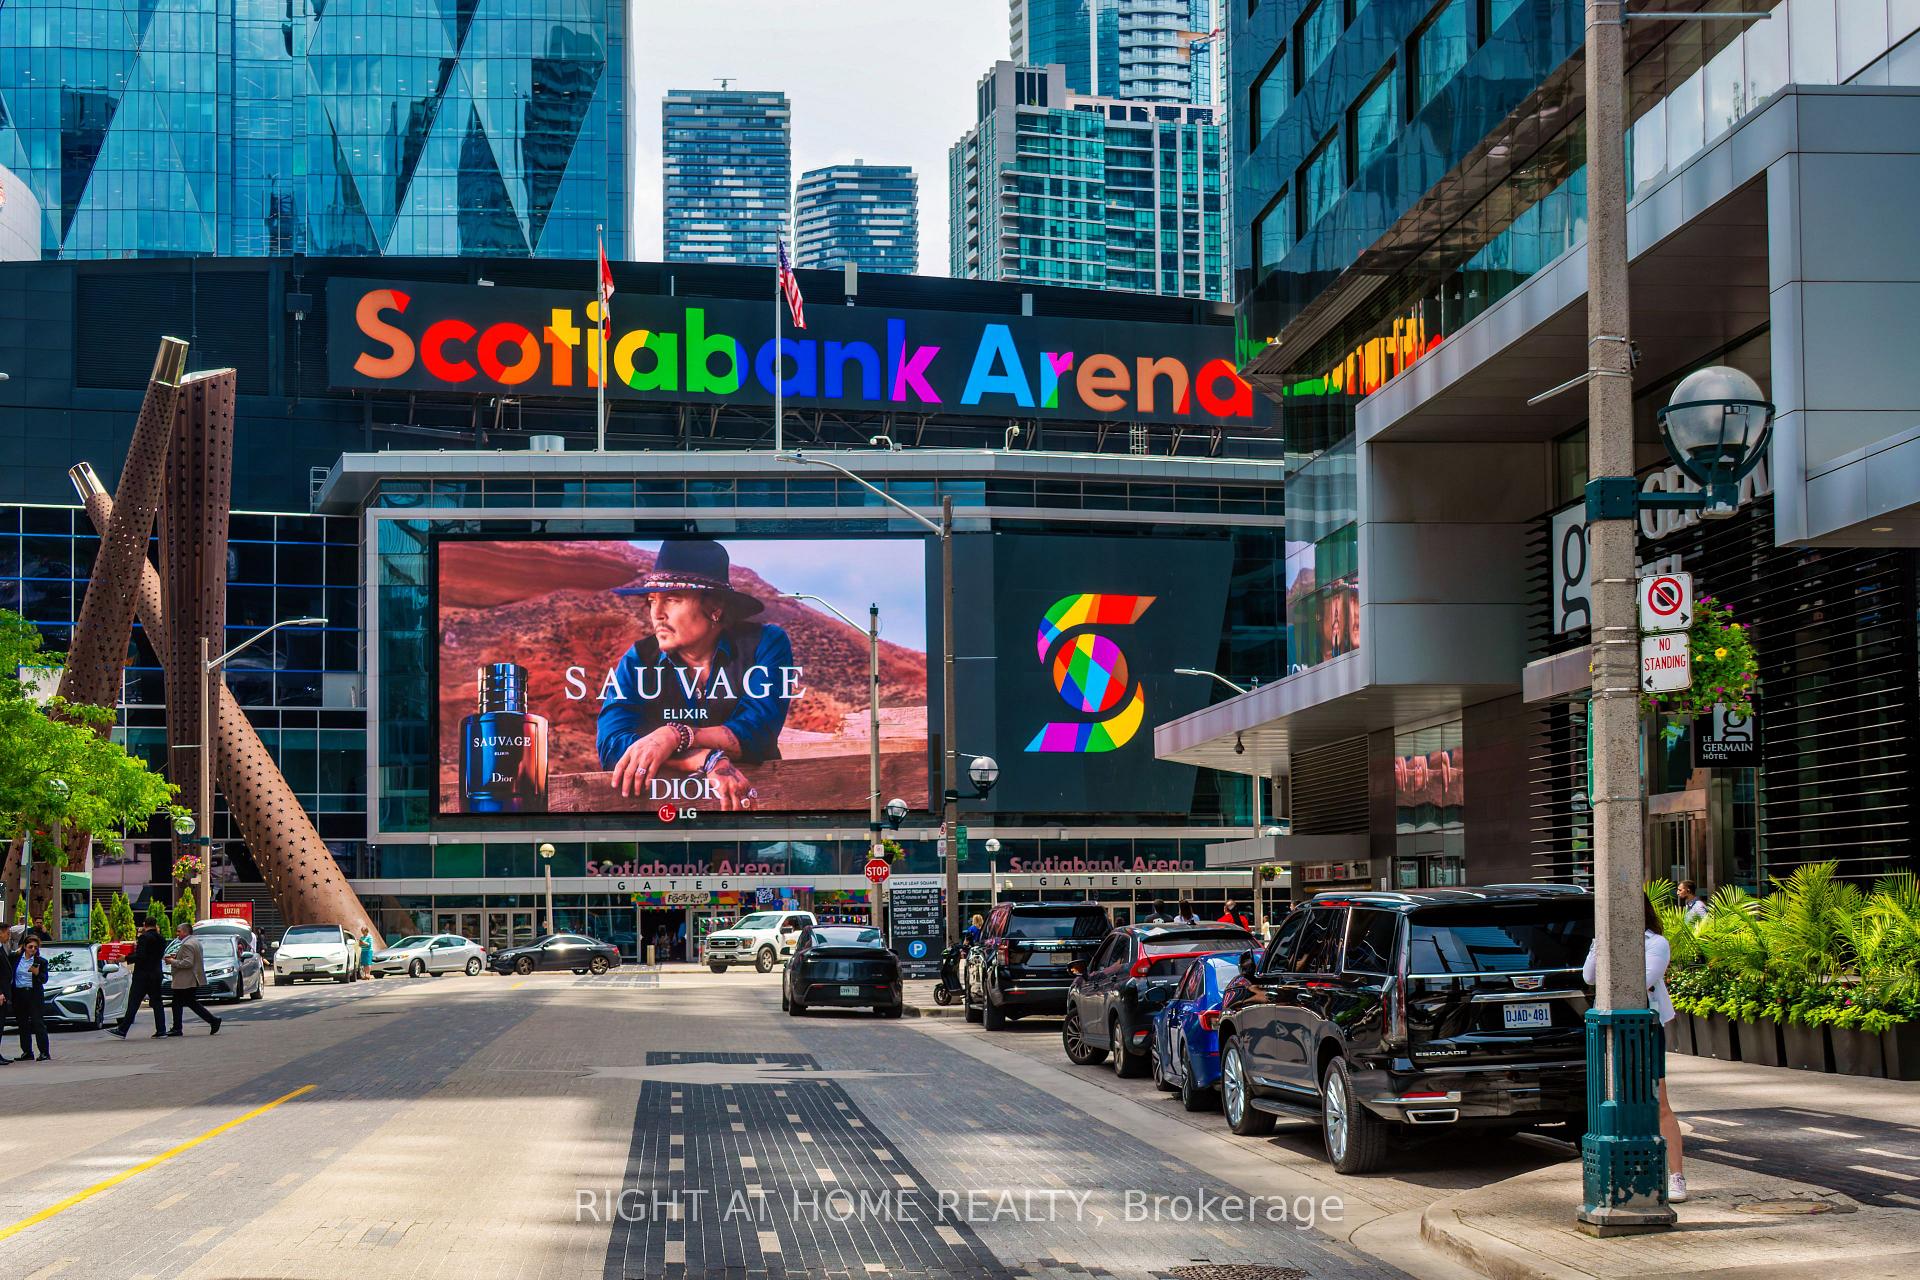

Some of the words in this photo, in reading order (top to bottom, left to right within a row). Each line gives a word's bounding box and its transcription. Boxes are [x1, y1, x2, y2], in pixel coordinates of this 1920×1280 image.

[354, 289, 942, 403] Scotiabank
[959, 323, 1253, 418] Arena
[1658, 637, 1671, 651] NO
[1644, 654, 1686, 671] STANDING
[564, 666, 807, 700] SAUVAGE
[663, 708, 708, 720] ELIXIR
[473, 736, 532, 748] SAUVAGE
[1703, 743, 1753, 752] GERMAIN
[1703, 752, 1728, 760] HÔTEL
[492, 772, 513, 783] Dior
[649, 776, 722, 800] DIOR
[679, 807, 697, 819] LG
[586, 859, 709, 877] Scotiabank
[718, 859, 786, 876] Arena
[866, 866, 889, 876] STOP
[1009, 856, 1125, 873] Scotiabank
[1132, 856, 1194, 872] Arena
[1505, 1009, 1528, 1022] DJAD
